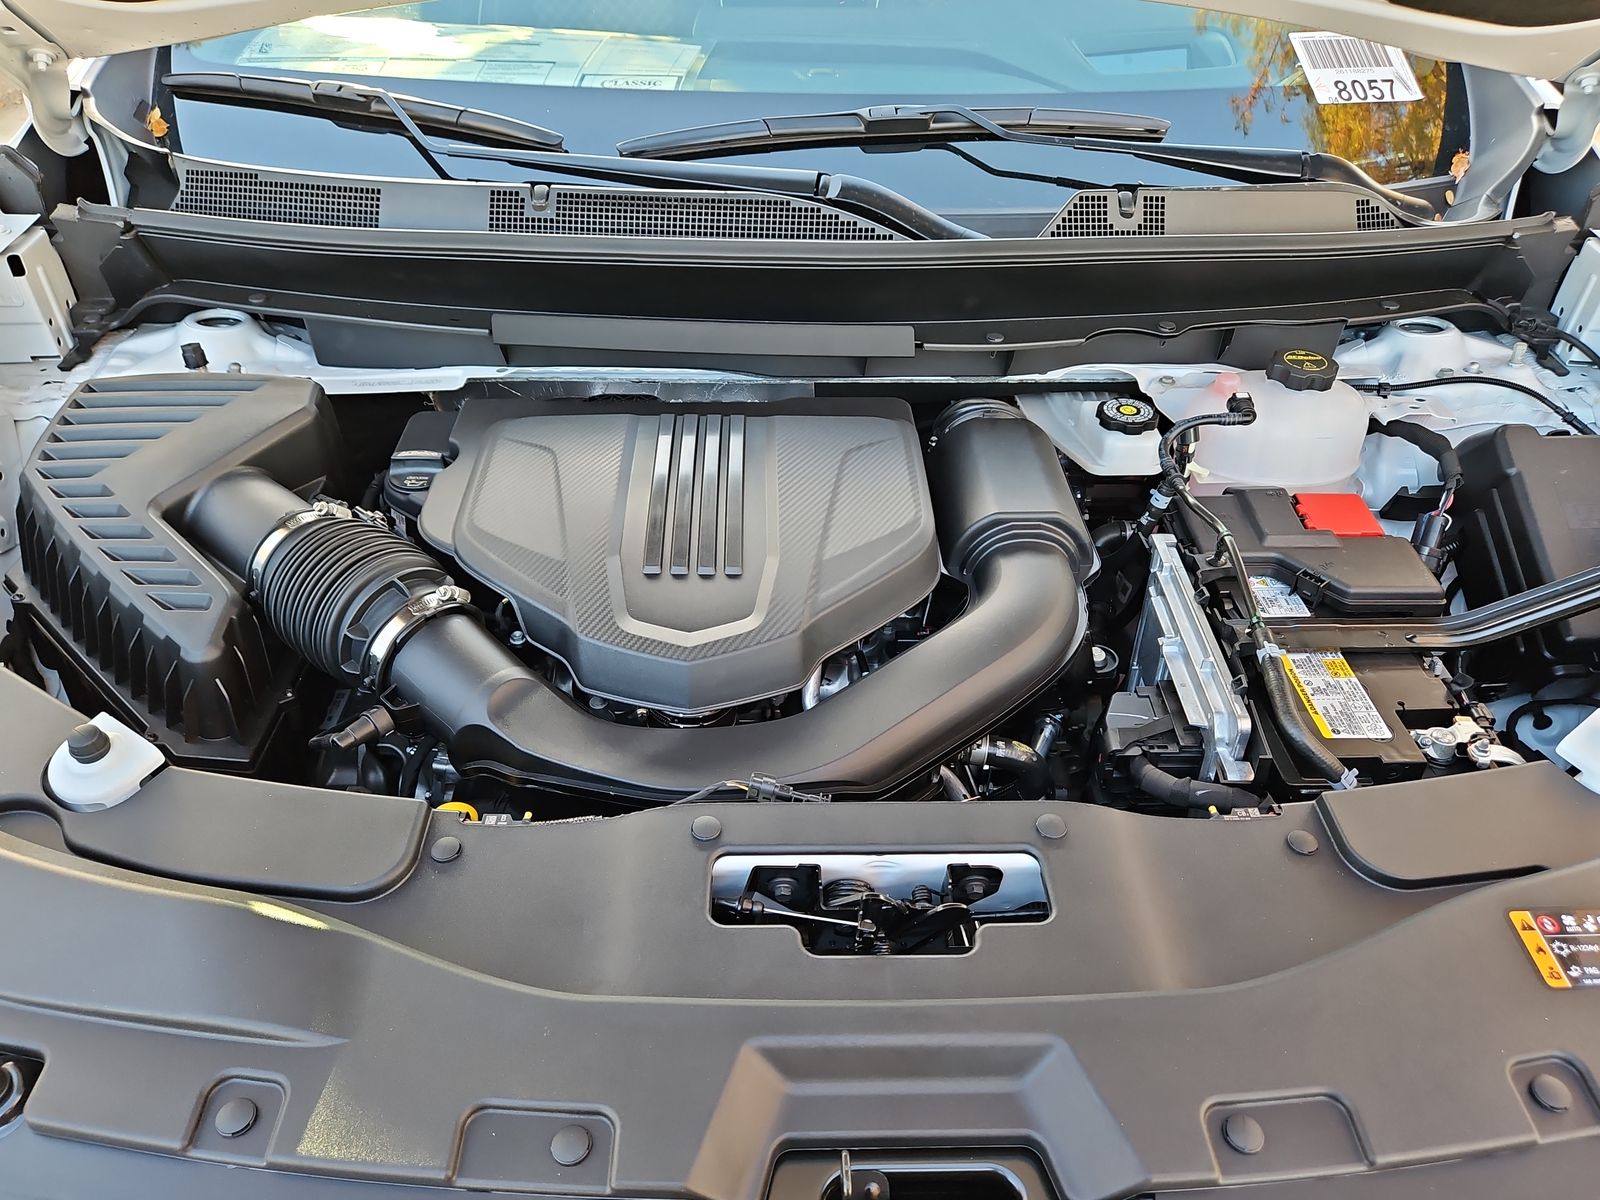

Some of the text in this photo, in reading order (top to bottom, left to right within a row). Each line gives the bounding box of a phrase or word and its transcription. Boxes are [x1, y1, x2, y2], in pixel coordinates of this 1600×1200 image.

[600, 79, 662, 88] CLASSIC
[1333, 79, 1396, 102] 8057
[1288, 669, 1315, 711] DANGER POISON
